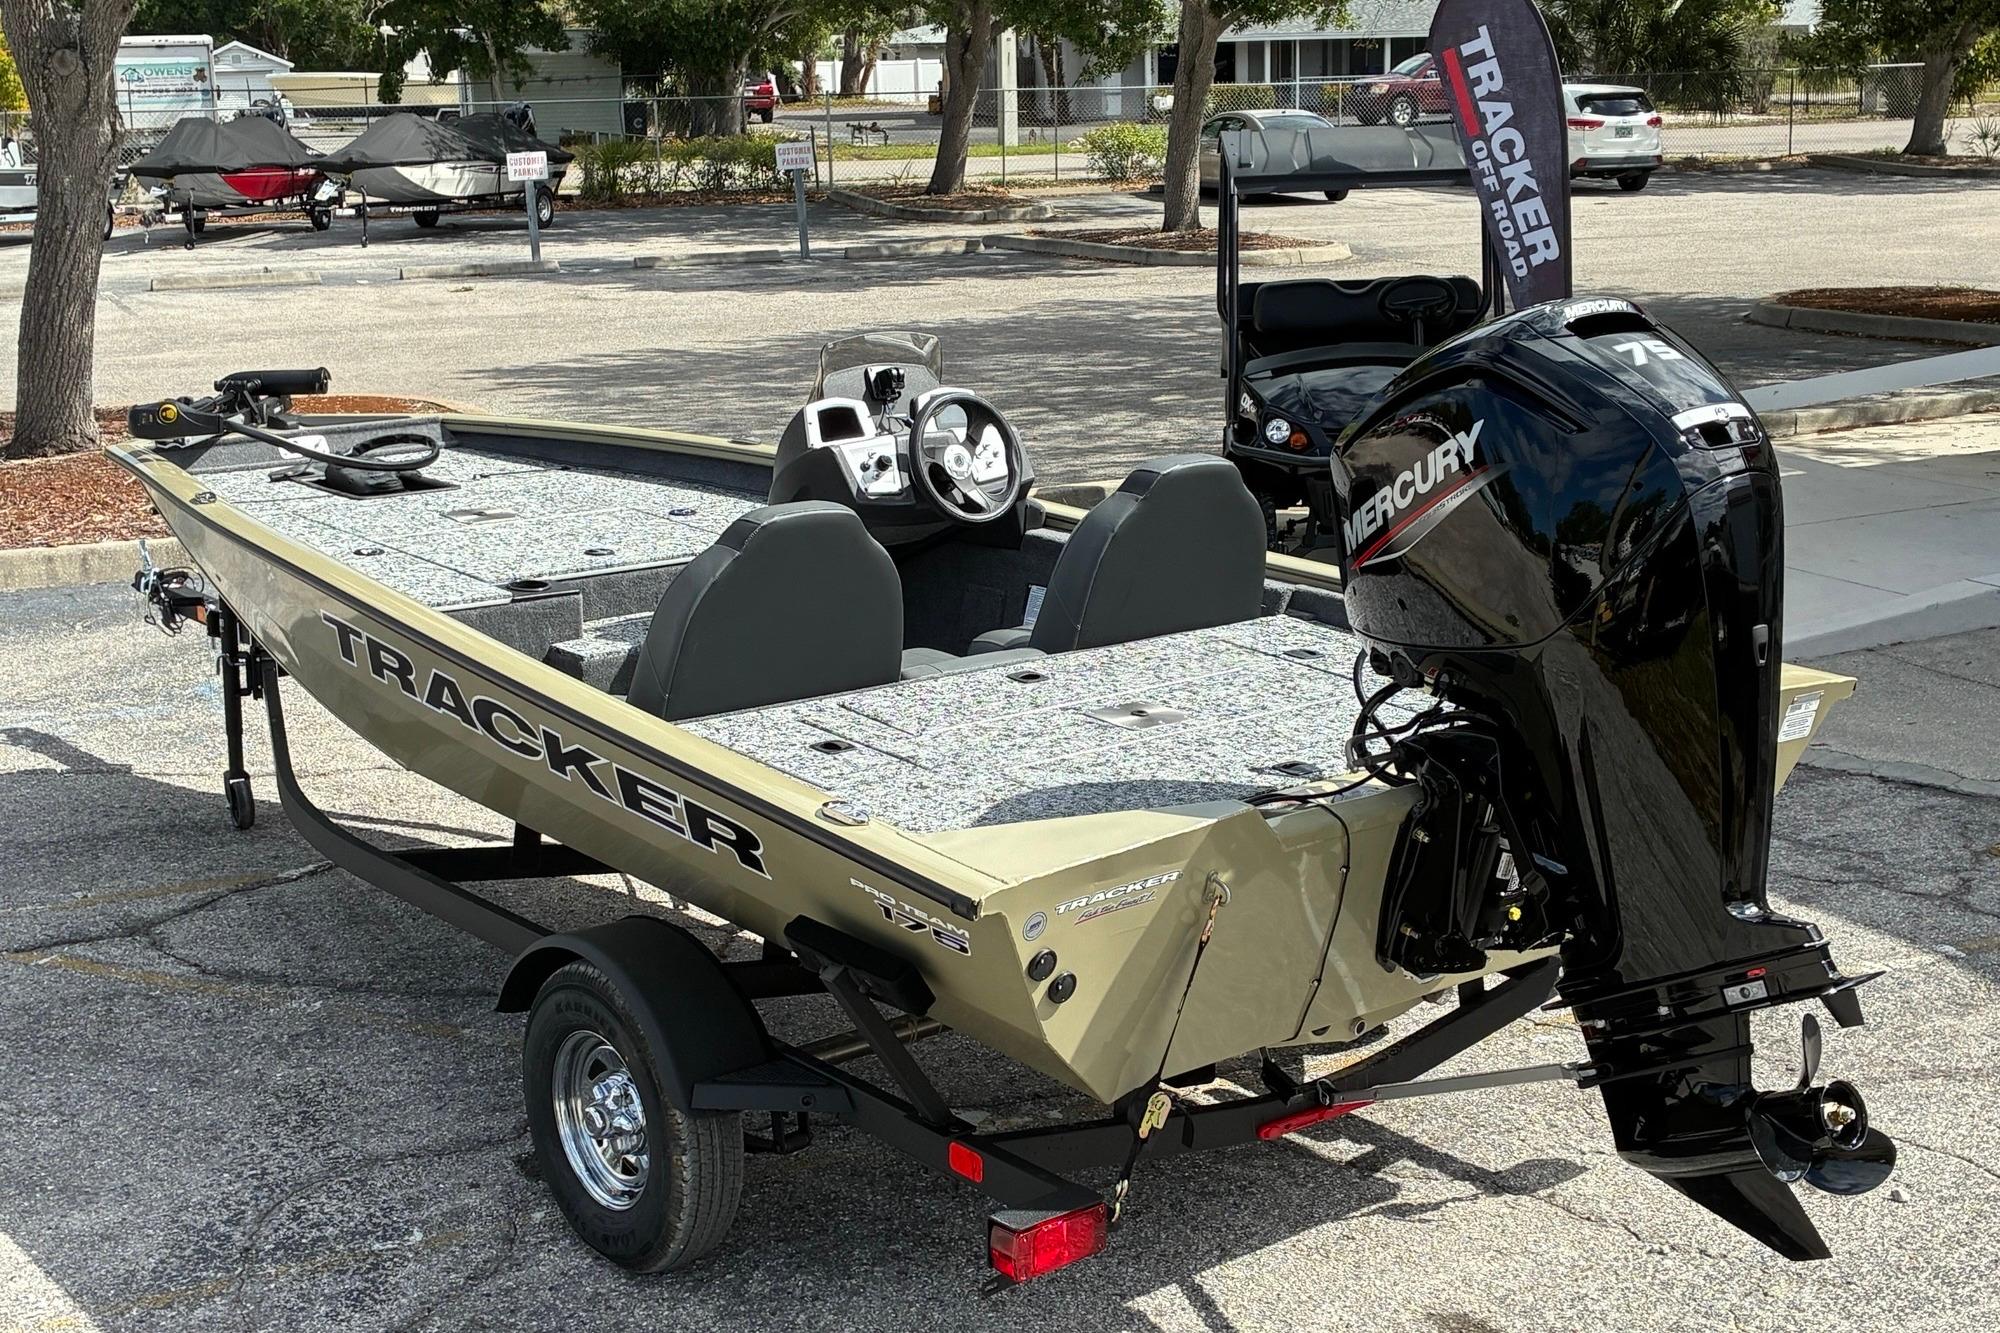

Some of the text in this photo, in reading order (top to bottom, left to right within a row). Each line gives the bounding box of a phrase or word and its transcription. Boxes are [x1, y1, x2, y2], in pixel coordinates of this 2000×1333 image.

[143, 66, 192, 77] OWENS
[509, 156, 545, 166] CUSTOMER
[1460, 24, 1560, 268] TRACKER
[513, 168, 544, 177] PARKING
[389, 205, 437, 213] TRACKER
[1472, 140, 1529, 277] OFF ROAD
[1563, 300, 1629, 320] MERCURY
[1612, 339, 1685, 367] 75
[1343, 418, 1485, 556] MERCURY
[320, 609, 774, 881] TRACKER
[849, 877, 970, 939] PRO TEAM
[1054, 870, 1183, 916] TRACKER
[873, 899, 972, 957] 175
